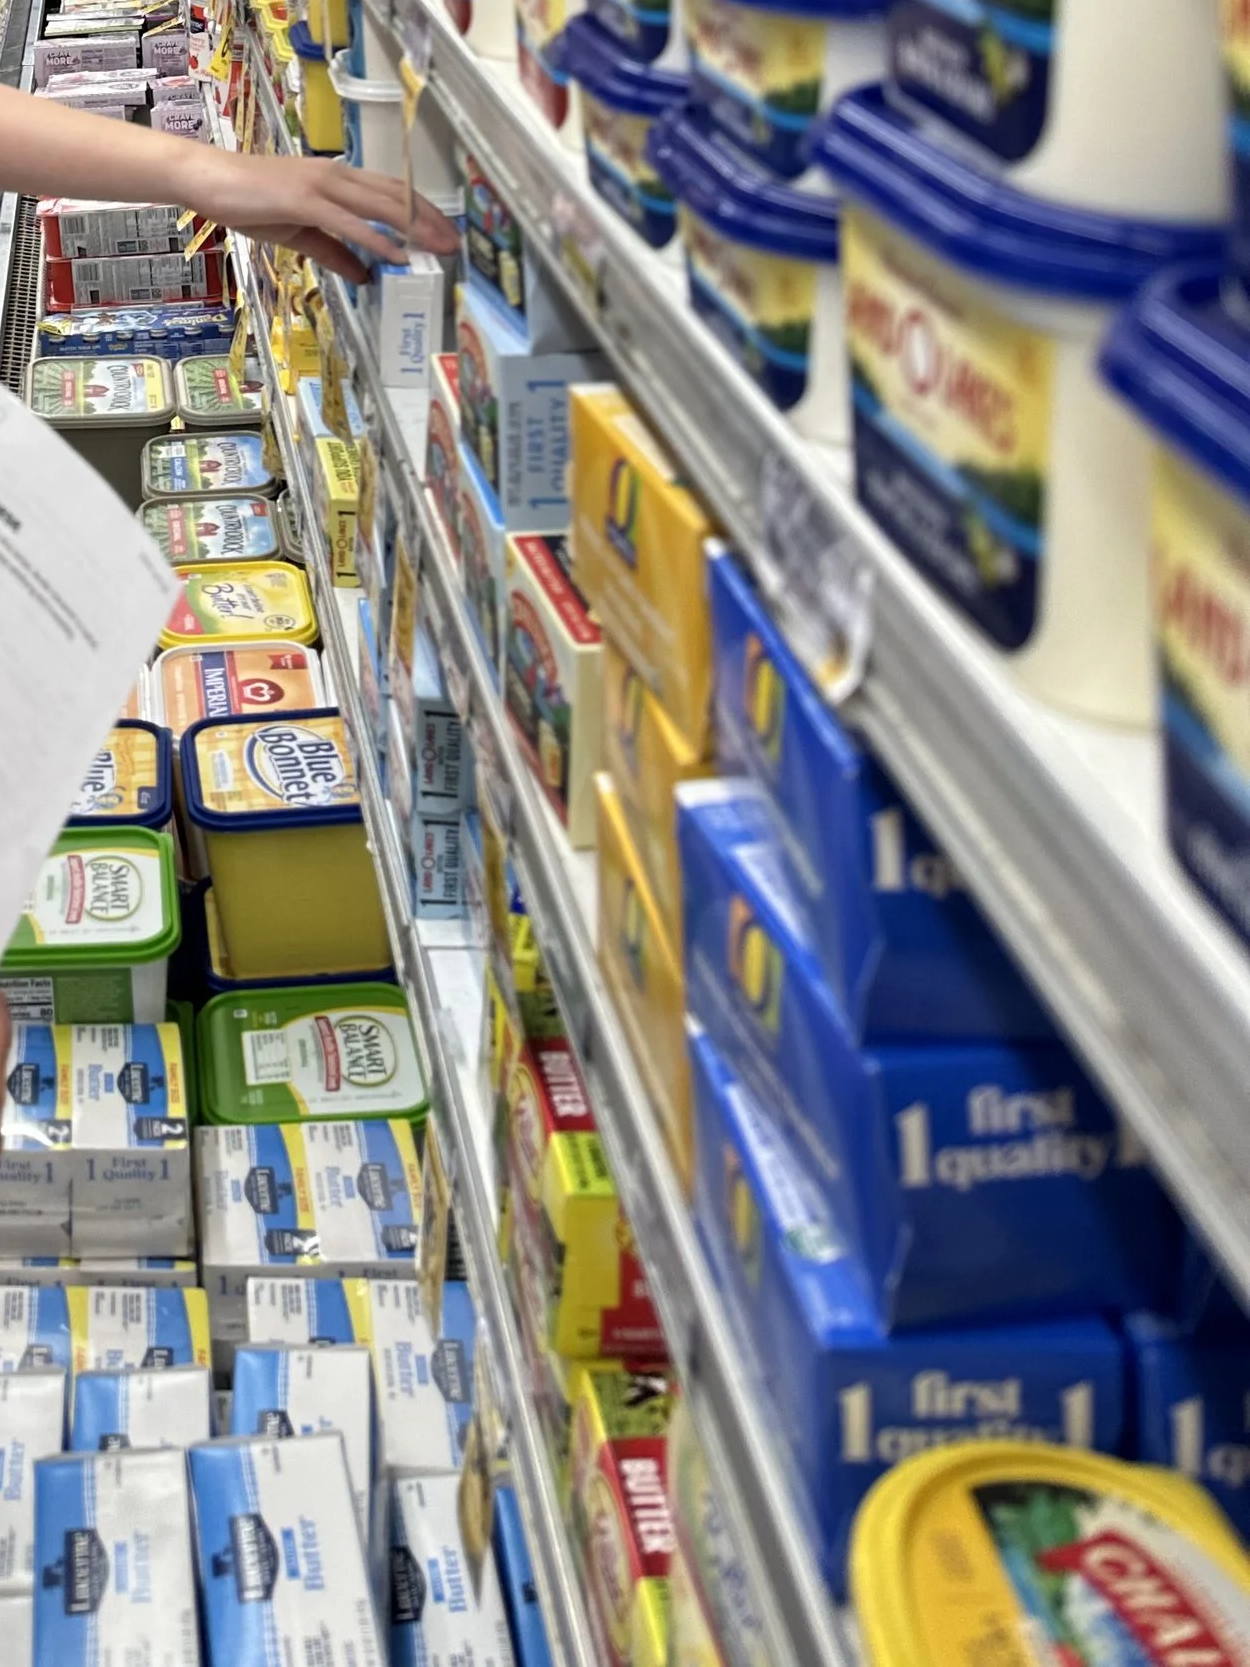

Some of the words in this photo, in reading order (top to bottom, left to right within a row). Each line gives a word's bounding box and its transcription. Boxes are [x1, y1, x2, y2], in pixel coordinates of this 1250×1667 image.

[164, 120, 196, 131] MORE
[526, 416, 544, 474] FIRST
[204, 667, 230, 718] IMPERIA
[259, 731, 317, 806] Bonnet
[297, 741, 339, 784] Blue
[444, 764, 459, 791] FIRST
[443, 828, 459, 868] QUALITY
[88, 862, 109, 914] BALANCE
[109, 863, 130, 911] SMART
[443, 869, 458, 898] FIRST
[168, 1062, 178, 1085] FAMILY
[339, 1023, 367, 1079] BALANCE
[357, 1024, 387, 1075] SMART
[21, 1064, 37, 1104] Lucerne
[89, 1063, 103, 1102] Butter
[131, 1064, 145, 1104] Lucerne
[540, 1051, 588, 1117] BUTTER
[161, 1121, 184, 1134] 2
[968, 1084, 1075, 1134] first
[112, 1156, 146, 1168] First
[896, 1101, 930, 1188] 1
[937, 1133, 1110, 1191] quality
[103, 1166, 157, 1183] Quality
[255, 1168, 272, 1212] Lucerne
[326, 1166, 343, 1208] Butter
[370, 1163, 387, 1208] Lucerne
[395, 1341, 414, 1397] Butter
[444, 1342, 462, 1400] Lucerne
[840, 1383, 871, 1463] 1
[912, 1369, 1022, 1420] first
[1171, 1396, 1202, 1476] 1
[4, 1437, 25, 1501] Butter
[619, 1457, 676, 1554] BUTTER
[70, 1531, 90, 1613] Lucerne
[237, 1515, 265, 1600] Lucerne
[300, 1514, 325, 1590] Butter
[442, 1545, 468, 1613] Butter
